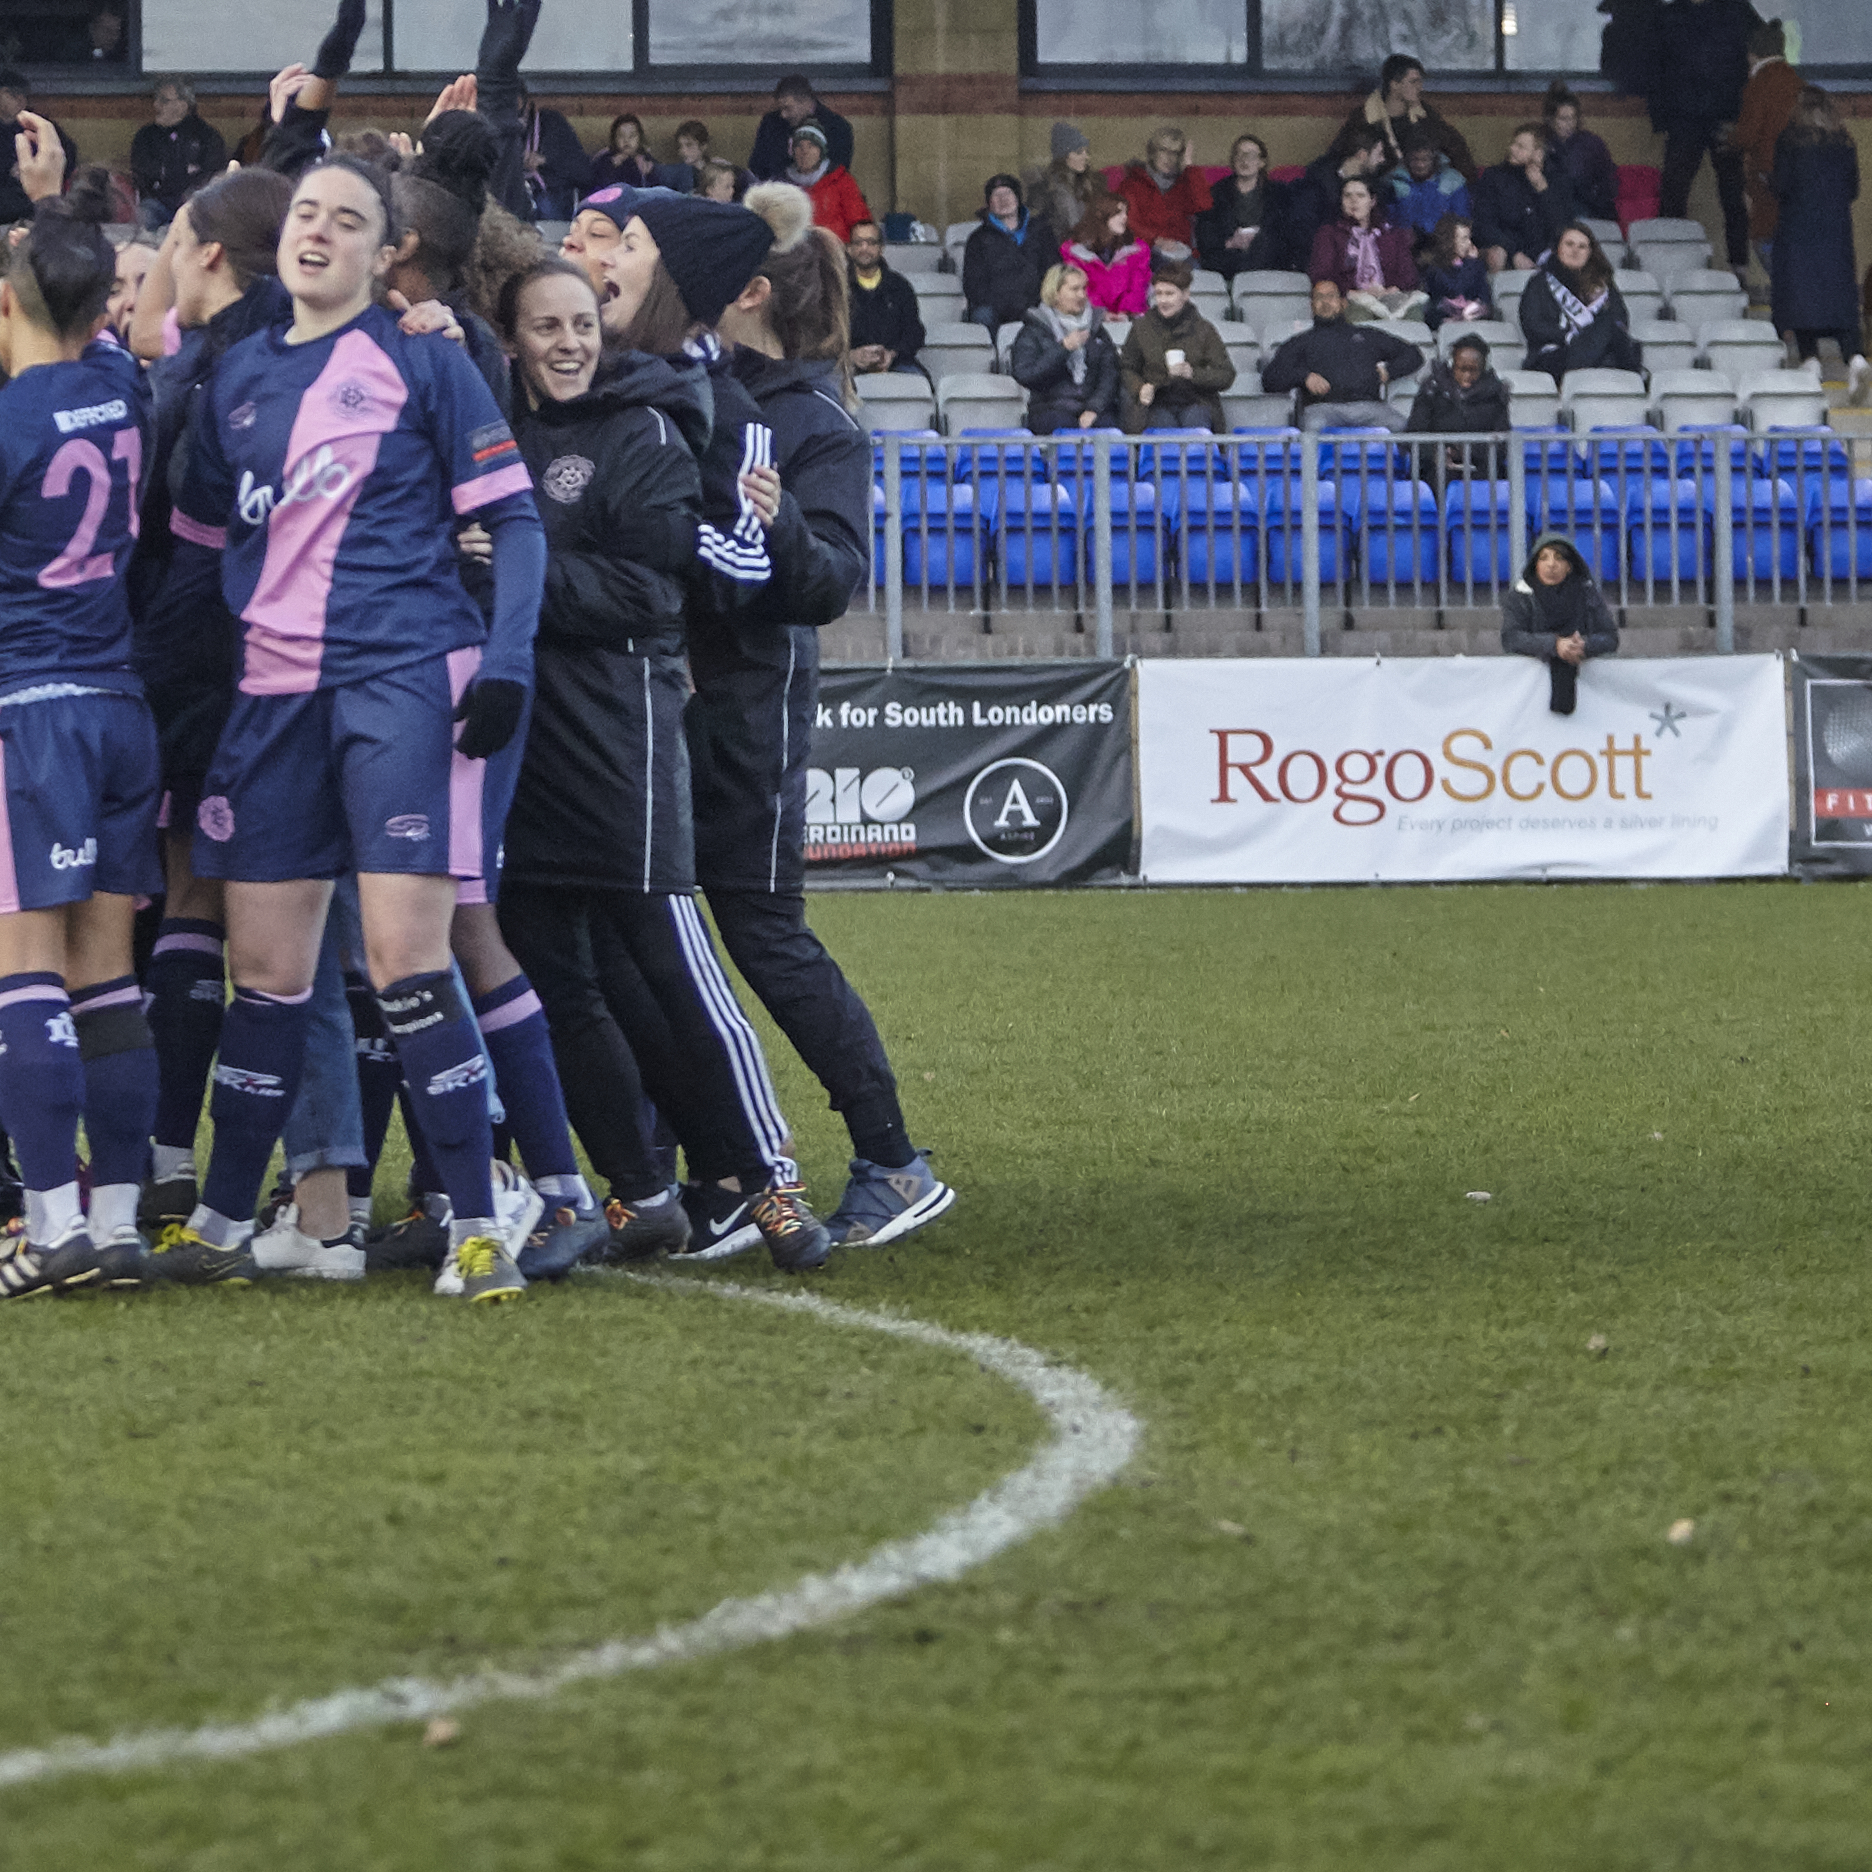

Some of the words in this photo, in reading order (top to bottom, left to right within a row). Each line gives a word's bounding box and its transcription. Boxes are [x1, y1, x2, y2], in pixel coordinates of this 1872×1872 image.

[37, 425, 143, 589] 21
[840, 701, 878, 728] for
[884, 701, 965, 727] South
[972, 700, 1114, 726] Londoners
[1209, 727, 1652, 826] RogoScott
[993, 778, 1041, 827] A
[1397, 815, 1444, 834] Every
[1449, 816, 1513, 834] project
[1518, 814, 1597, 829] deserves
[1602, 817, 1614, 829] a
[1619, 813, 1665, 829] silver
[1670, 813, 1719, 831] lining
